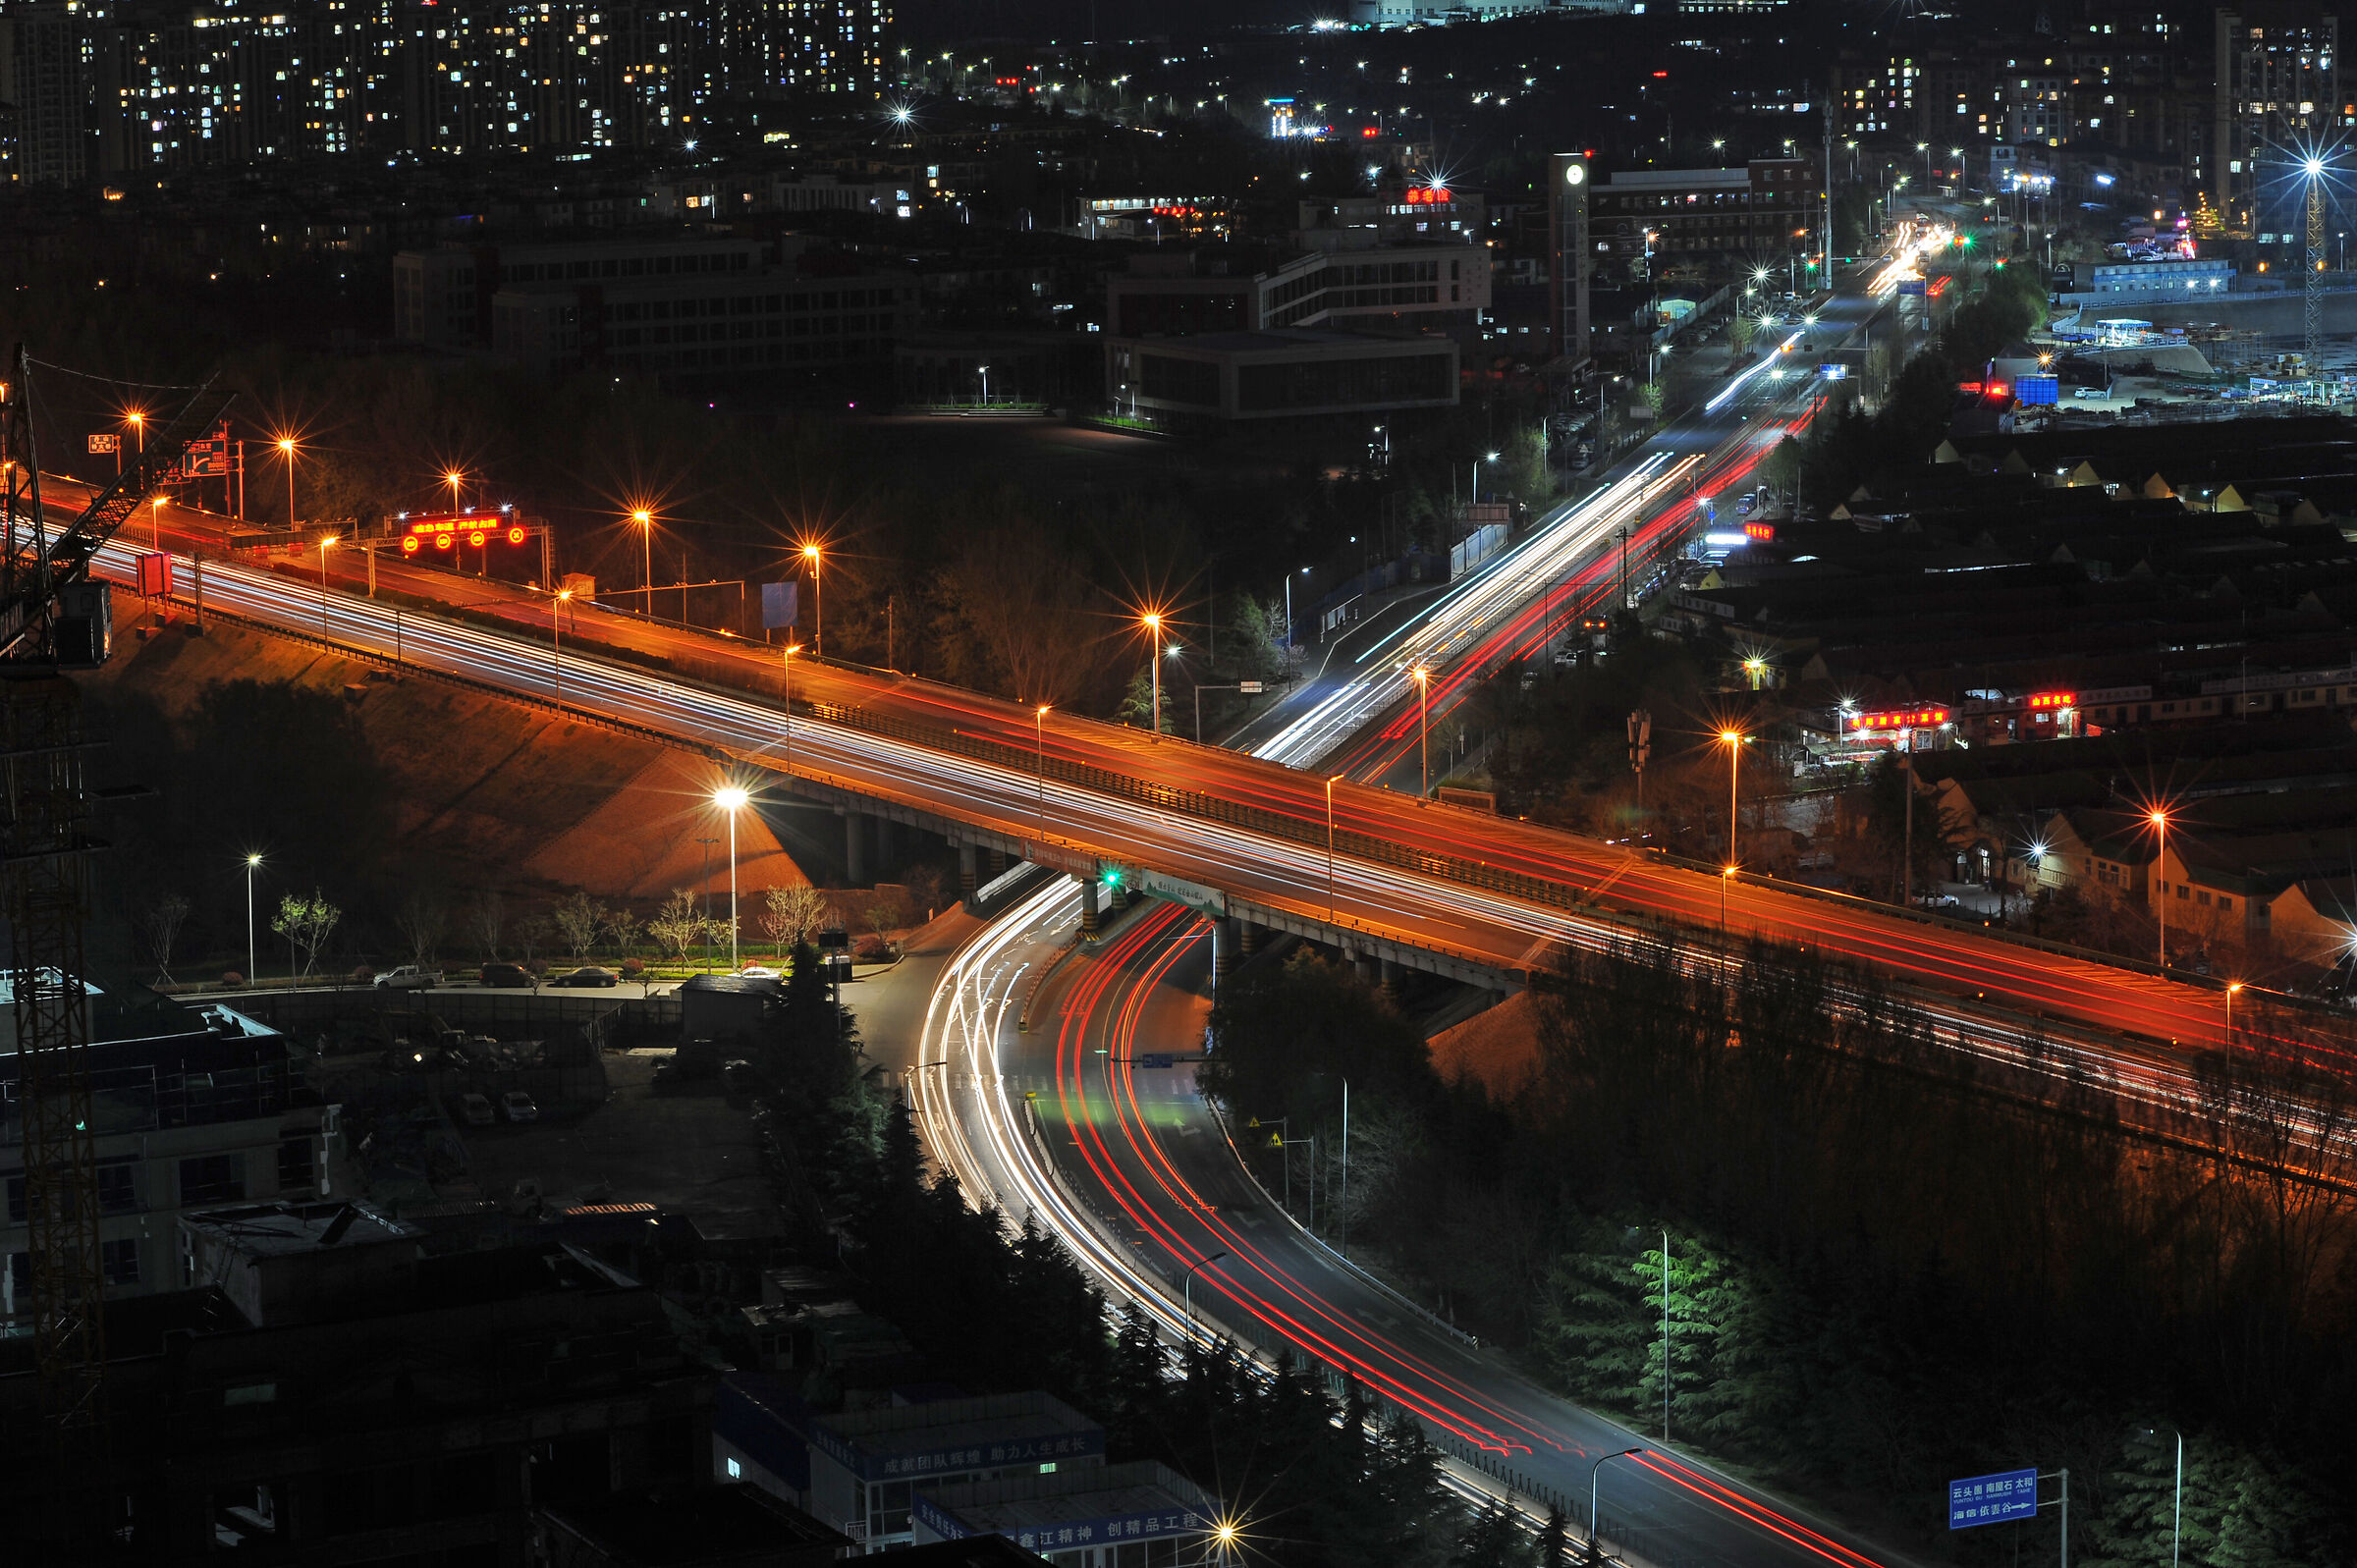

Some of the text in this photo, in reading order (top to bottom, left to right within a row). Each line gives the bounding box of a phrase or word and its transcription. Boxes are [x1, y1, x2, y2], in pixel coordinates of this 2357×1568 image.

[411, 518, 497, 533] 应急车道 严禁占用
[884, 1436, 1086, 1474] 成就团队辉煌 助力人生成长
[2015, 1477, 2033, 1488] 太和
[1006, 1512, 1199, 1548] 鑫江精神 创精品工程
